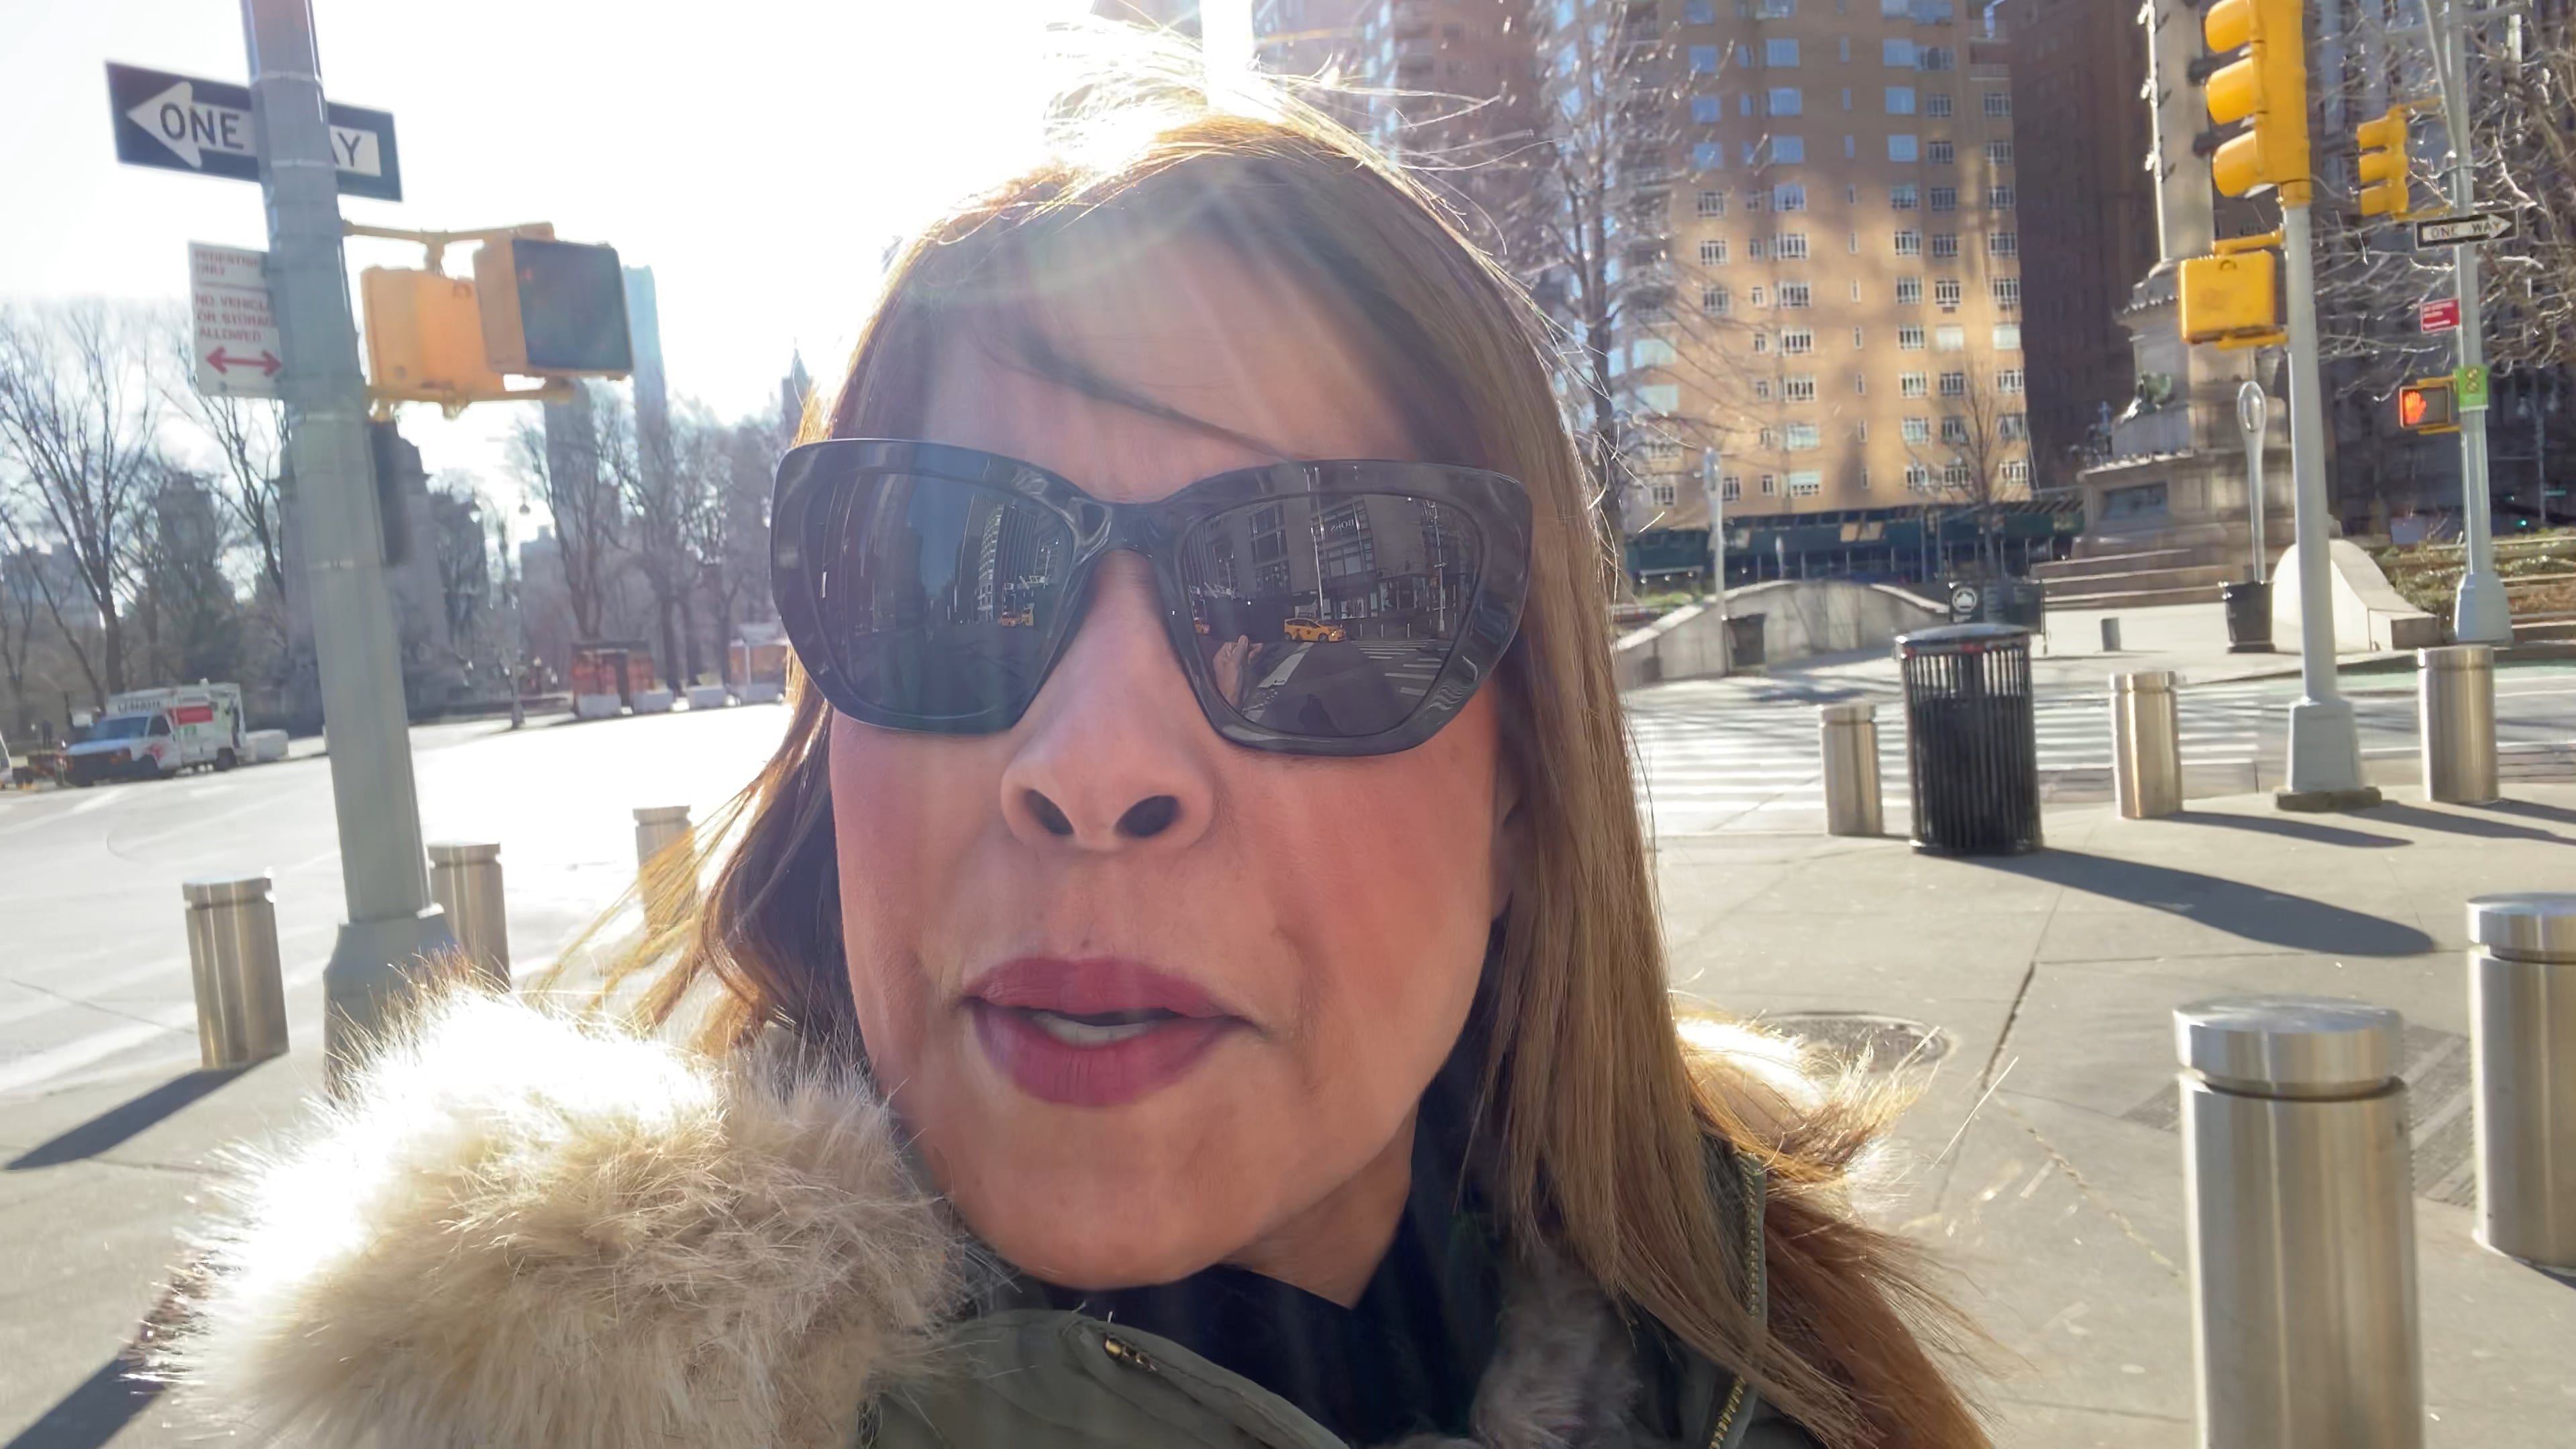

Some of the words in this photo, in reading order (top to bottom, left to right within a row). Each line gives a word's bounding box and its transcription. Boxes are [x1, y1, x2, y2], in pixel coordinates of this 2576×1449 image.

[160, 104, 245, 150] ONE
[2430, 225, 2459, 239] ONE
[2472, 220, 2502, 233] WAY
[195, 293, 215, 307] NO
